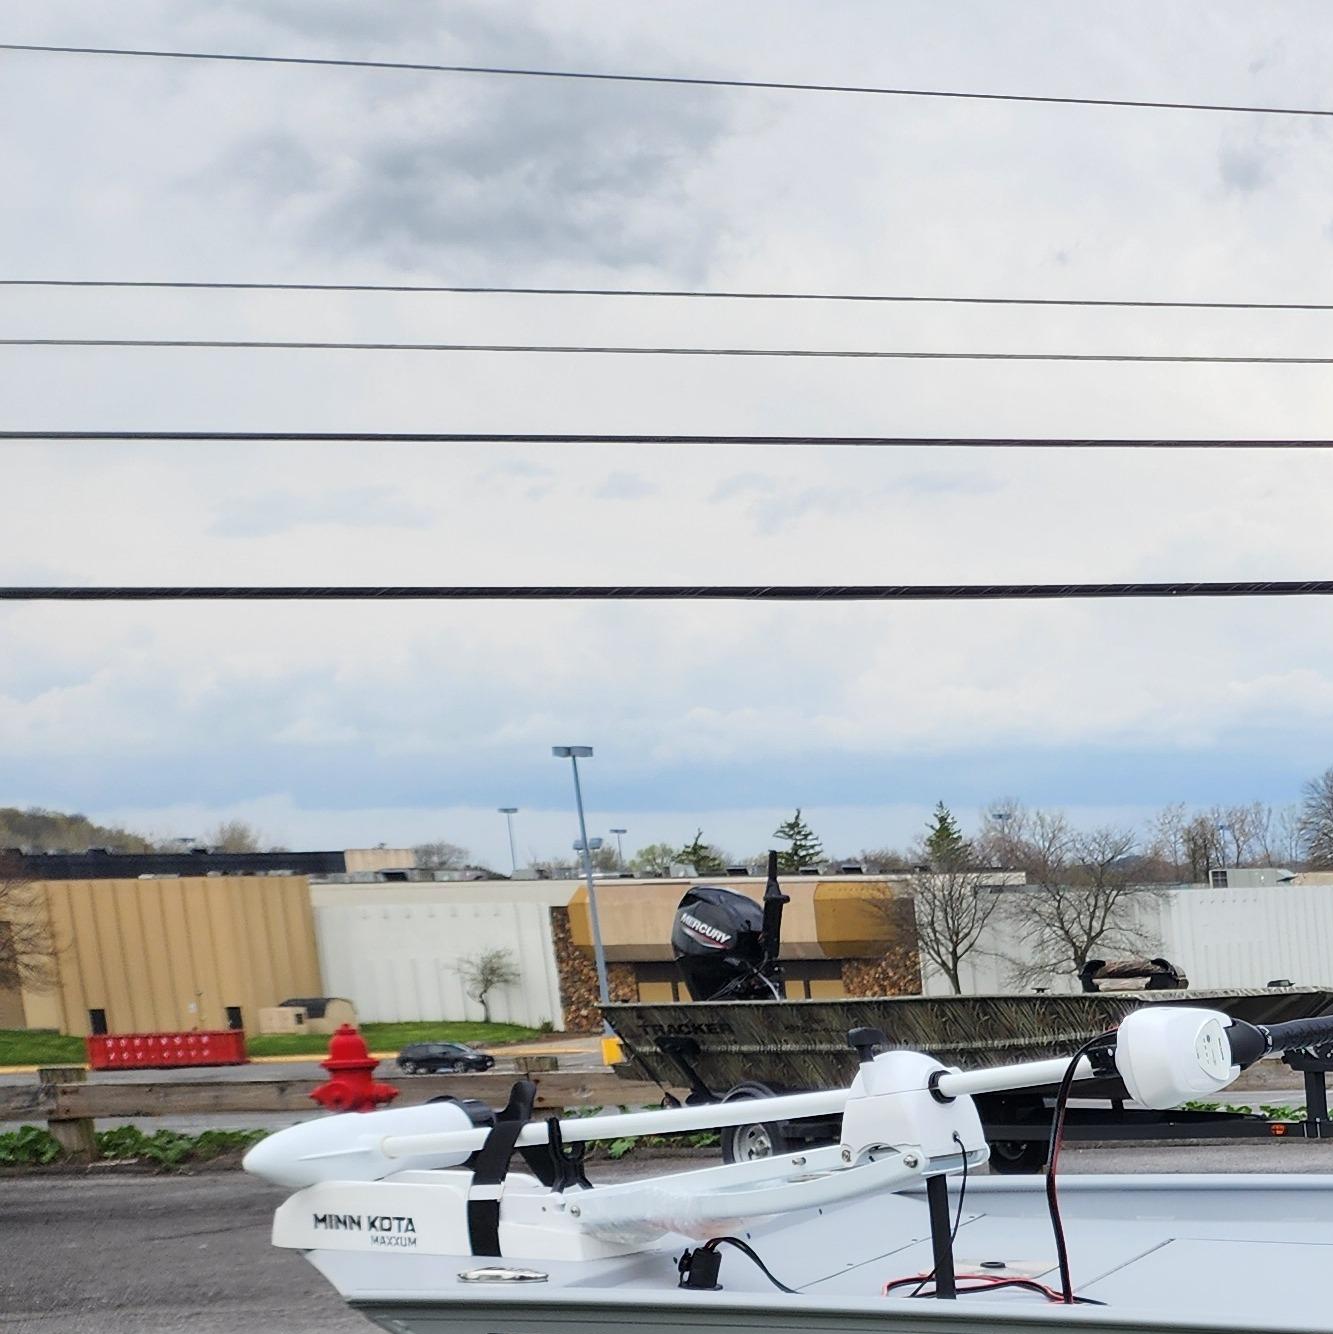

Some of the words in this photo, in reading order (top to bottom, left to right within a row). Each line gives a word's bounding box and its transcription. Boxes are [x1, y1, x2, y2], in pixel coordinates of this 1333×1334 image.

[680, 912, 732, 944] MERCURY
[313, 1213, 362, 1231] MINN
[367, 1216, 417, 1233] KOTA
[370, 1235, 417, 1248] MAXXUM
